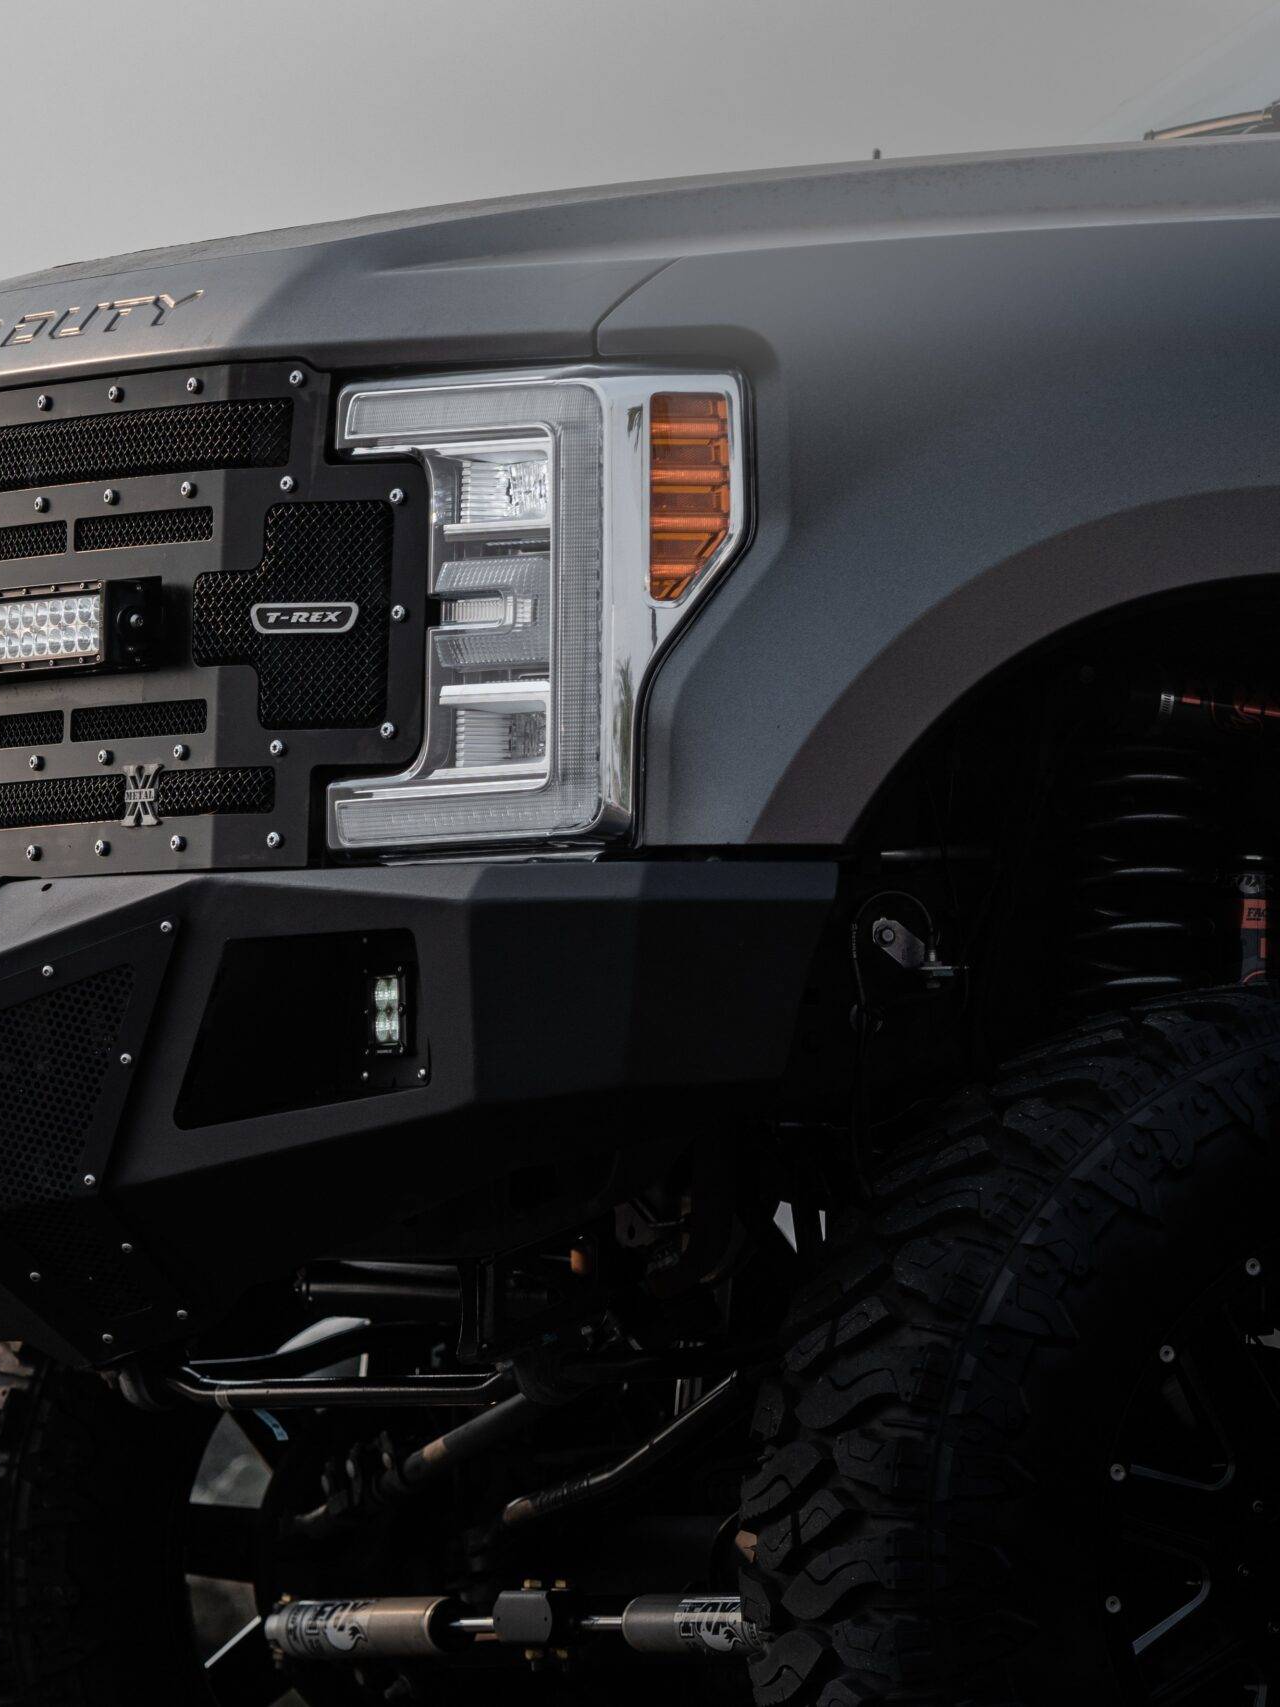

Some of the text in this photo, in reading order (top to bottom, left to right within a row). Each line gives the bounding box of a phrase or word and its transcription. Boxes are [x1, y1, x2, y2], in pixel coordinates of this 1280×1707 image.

[0, 289, 205, 349] DUTY
[265, 610, 343, 624] T-REX
[125, 790, 154, 802] METAL
